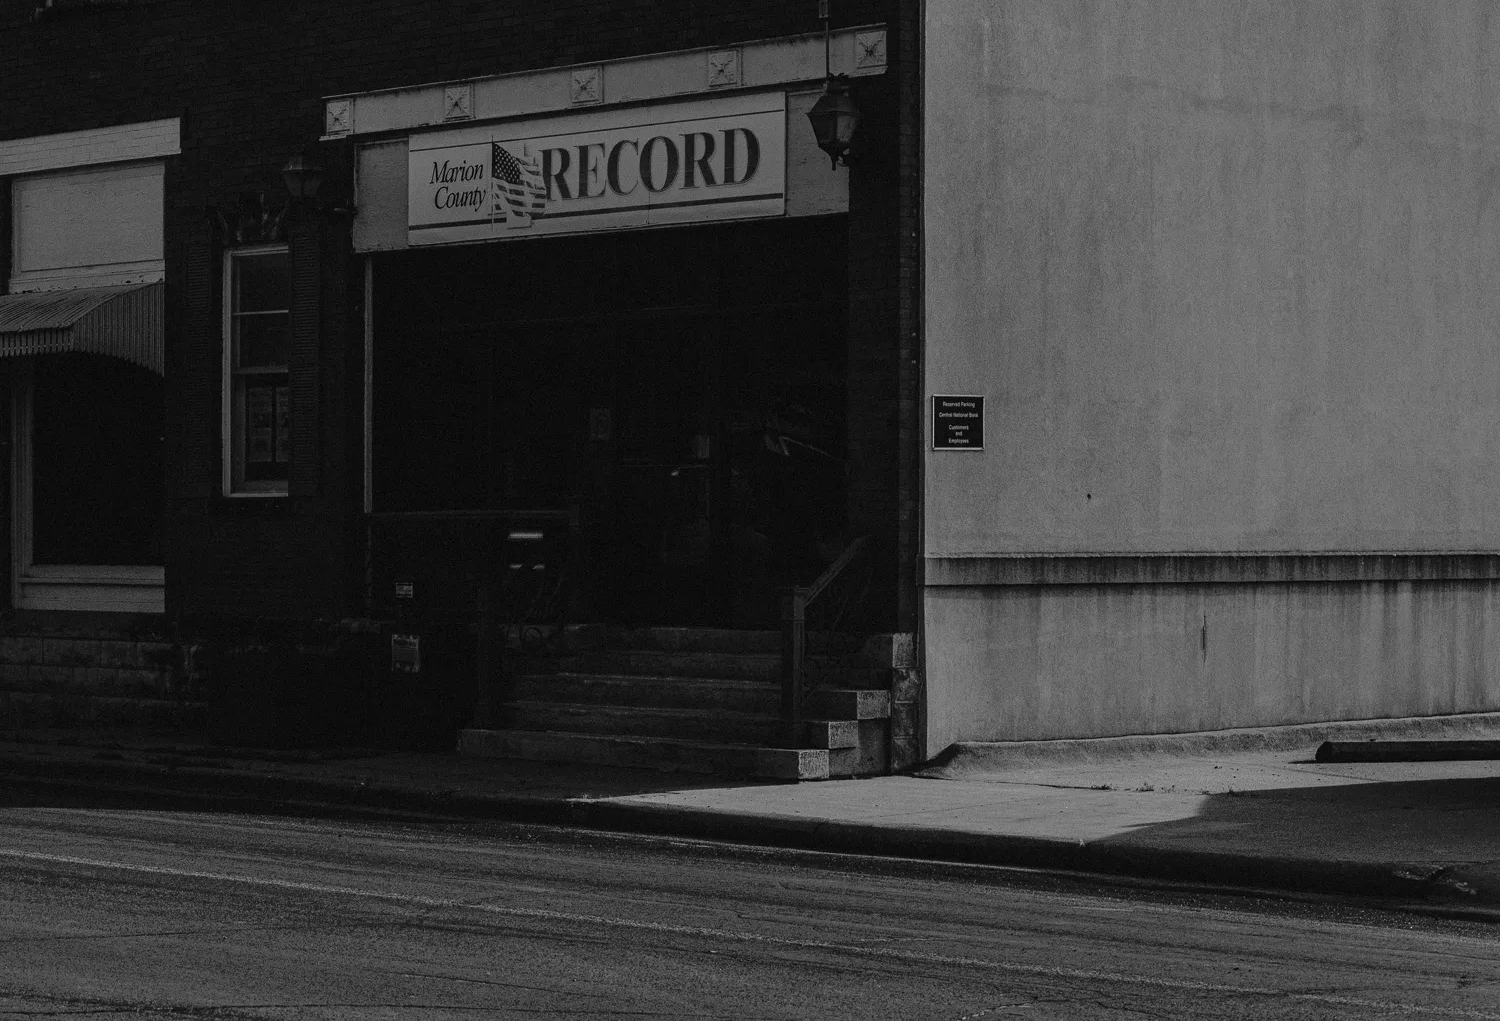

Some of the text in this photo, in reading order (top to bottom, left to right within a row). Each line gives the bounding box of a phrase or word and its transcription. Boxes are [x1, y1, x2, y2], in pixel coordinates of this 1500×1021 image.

[429, 159, 484, 184] Marion
[538, 127, 761, 202] RECORD
[434, 186, 487, 212] County
